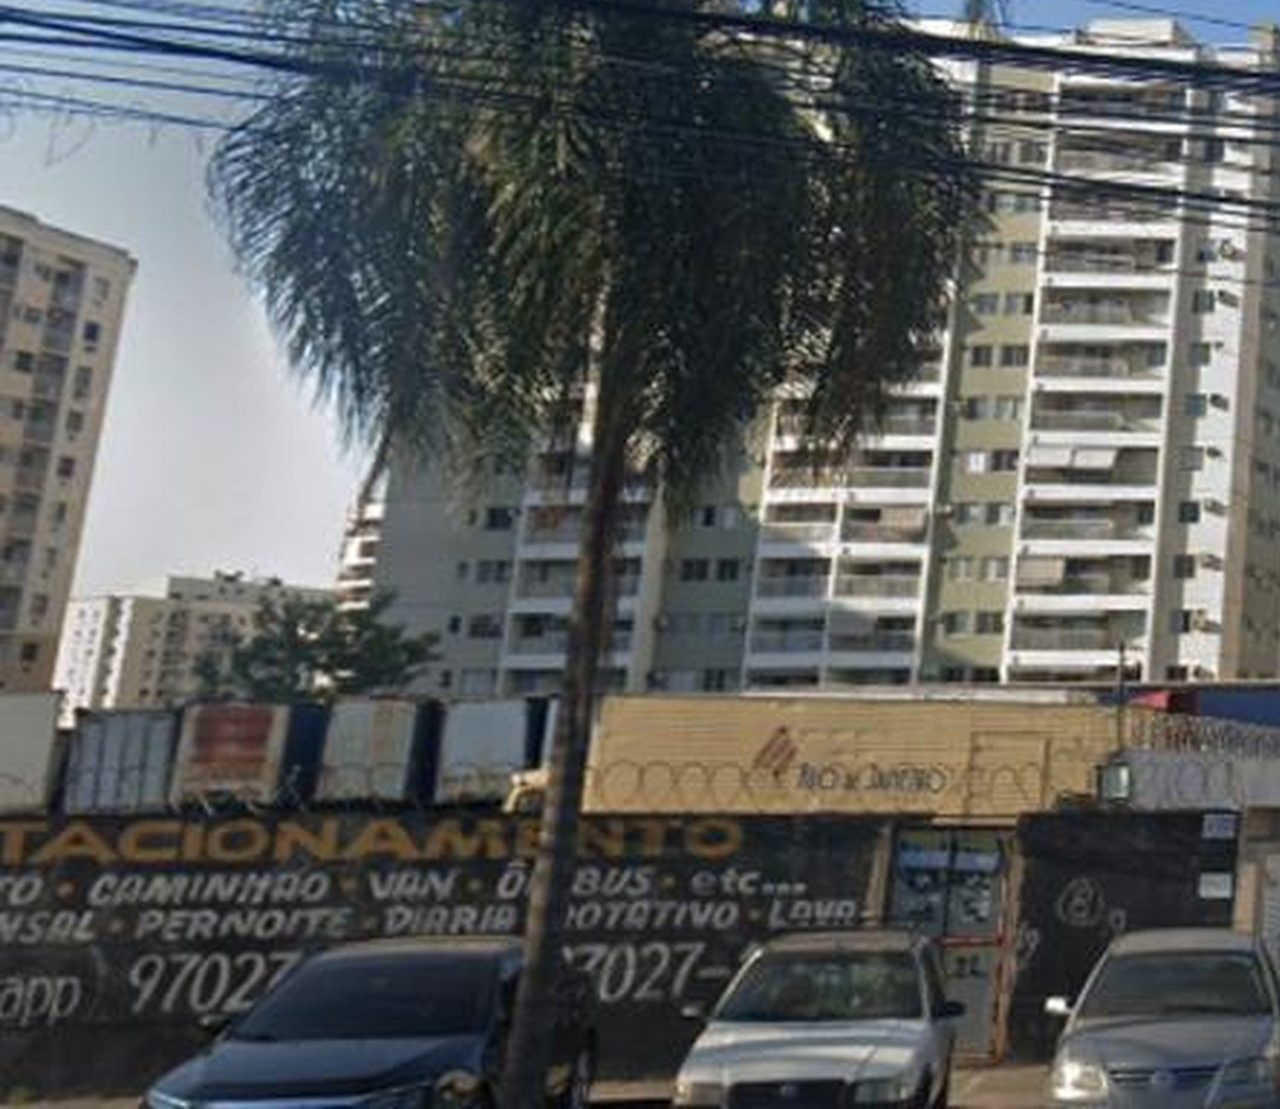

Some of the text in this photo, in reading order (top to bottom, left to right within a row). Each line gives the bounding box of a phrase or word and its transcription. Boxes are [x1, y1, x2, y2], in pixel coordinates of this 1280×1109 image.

[369, 869, 460, 900] VAN
[496, 859, 651, 899] ÔBUS
[135, 907, 353, 942] PERNOITE
[384, 904, 518, 935] DIARIA
